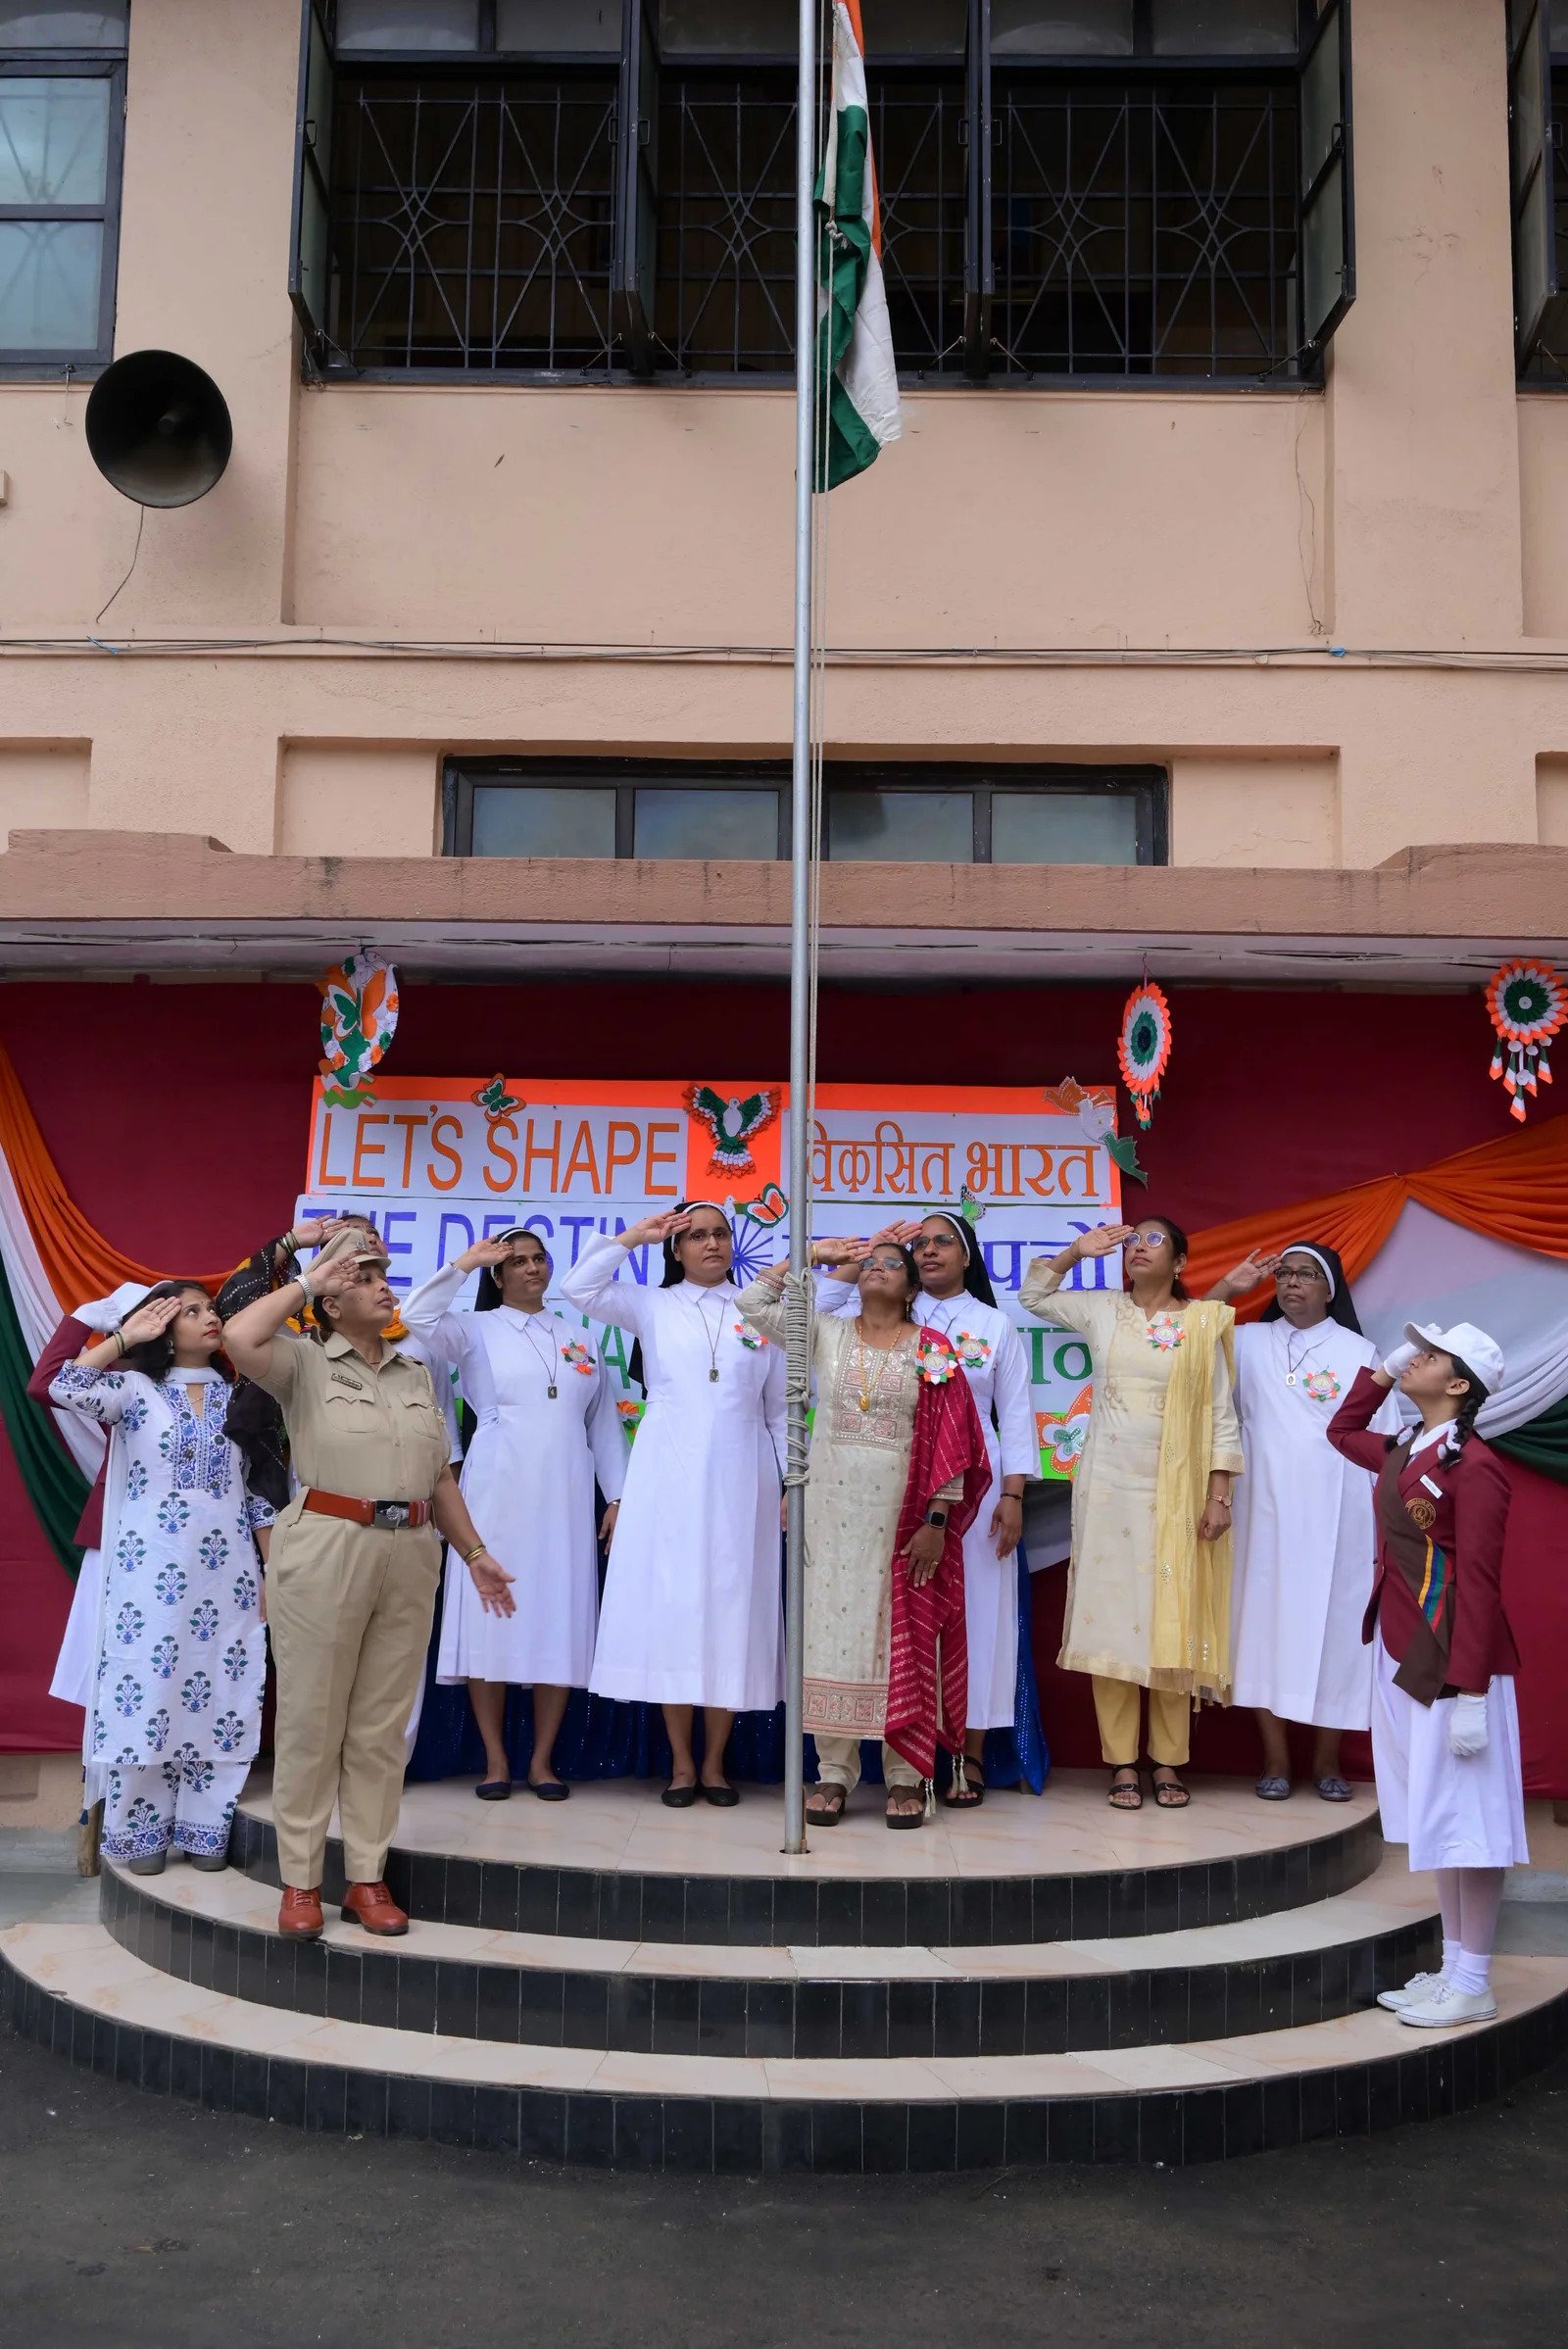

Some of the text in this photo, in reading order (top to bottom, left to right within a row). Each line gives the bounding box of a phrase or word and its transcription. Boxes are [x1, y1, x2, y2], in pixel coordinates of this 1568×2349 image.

[318, 1104, 679, 1195] LET'S SHAPE
[966, 1142, 1101, 1197] भारत
[302, 1208, 417, 1287] TE
